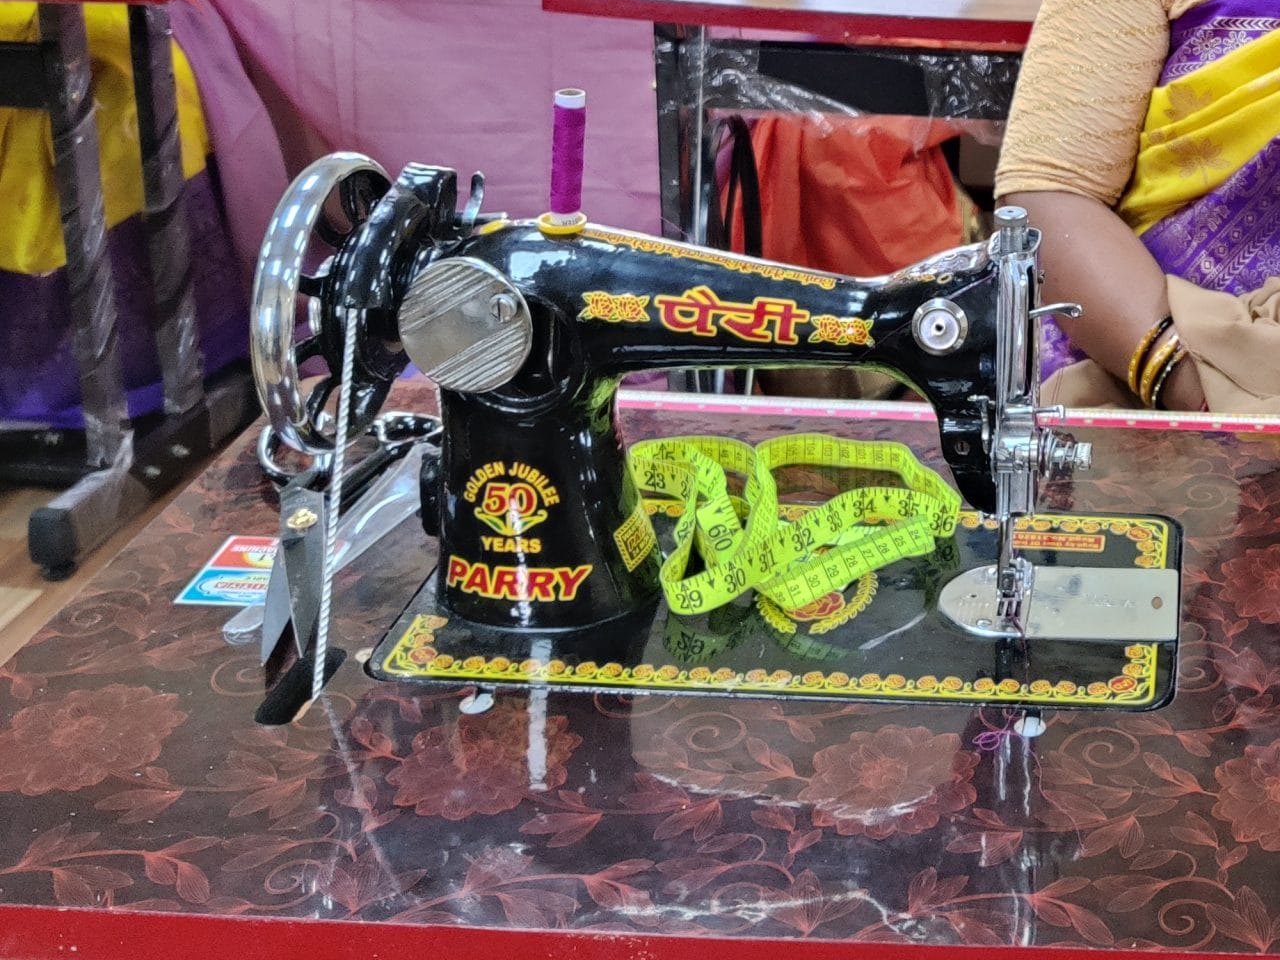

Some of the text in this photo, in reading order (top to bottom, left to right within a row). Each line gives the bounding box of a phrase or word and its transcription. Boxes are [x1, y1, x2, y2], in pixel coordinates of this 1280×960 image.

[654, 285, 810, 345] पैरी
[463, 461, 560, 507] GOLDEN JUBILEE
[644, 470, 666, 489] 23
[482, 482, 537, 516] 50
[481, 536, 542, 553] YEARS
[676, 498, 954, 609] 29 30 31 32 33 34 35 36
[708, 524, 733, 551] 60
[447, 555, 593, 602] PARRY
[808, 575, 820, 588] 30
[827, 565, 839, 578] 29
[846, 555, 858, 568] 28
